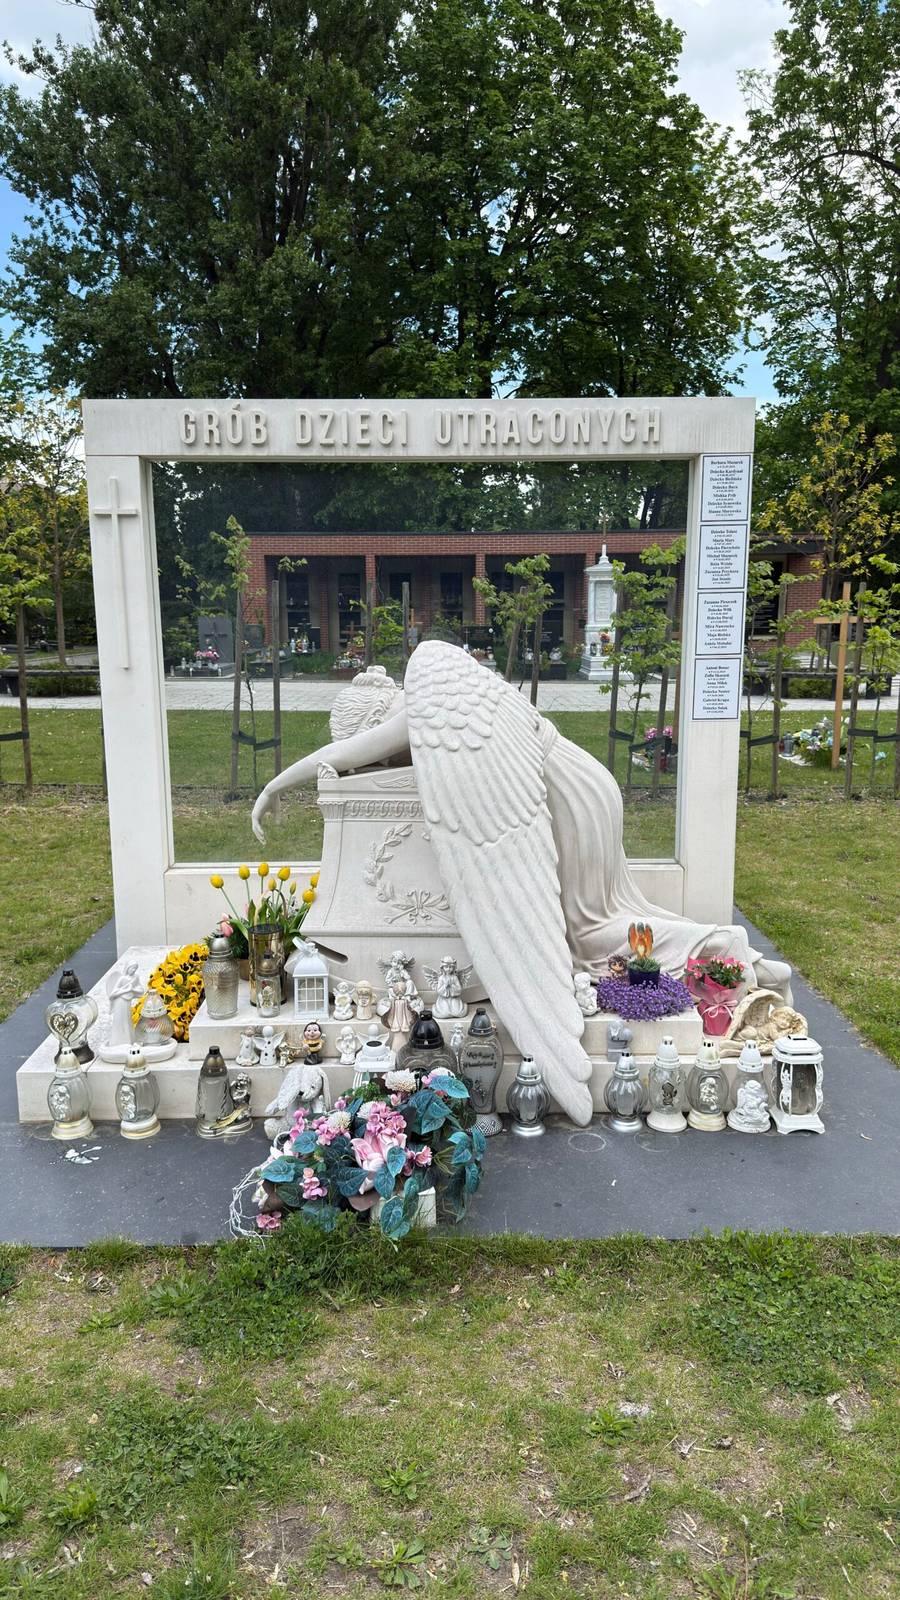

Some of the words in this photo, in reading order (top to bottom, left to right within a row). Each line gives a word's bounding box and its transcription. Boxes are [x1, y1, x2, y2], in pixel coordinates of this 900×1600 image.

[179, 402, 269, 446] GRÓB
[295, 408, 408, 446] DZIECI
[435, 407, 663, 446] UTRACONYCH
